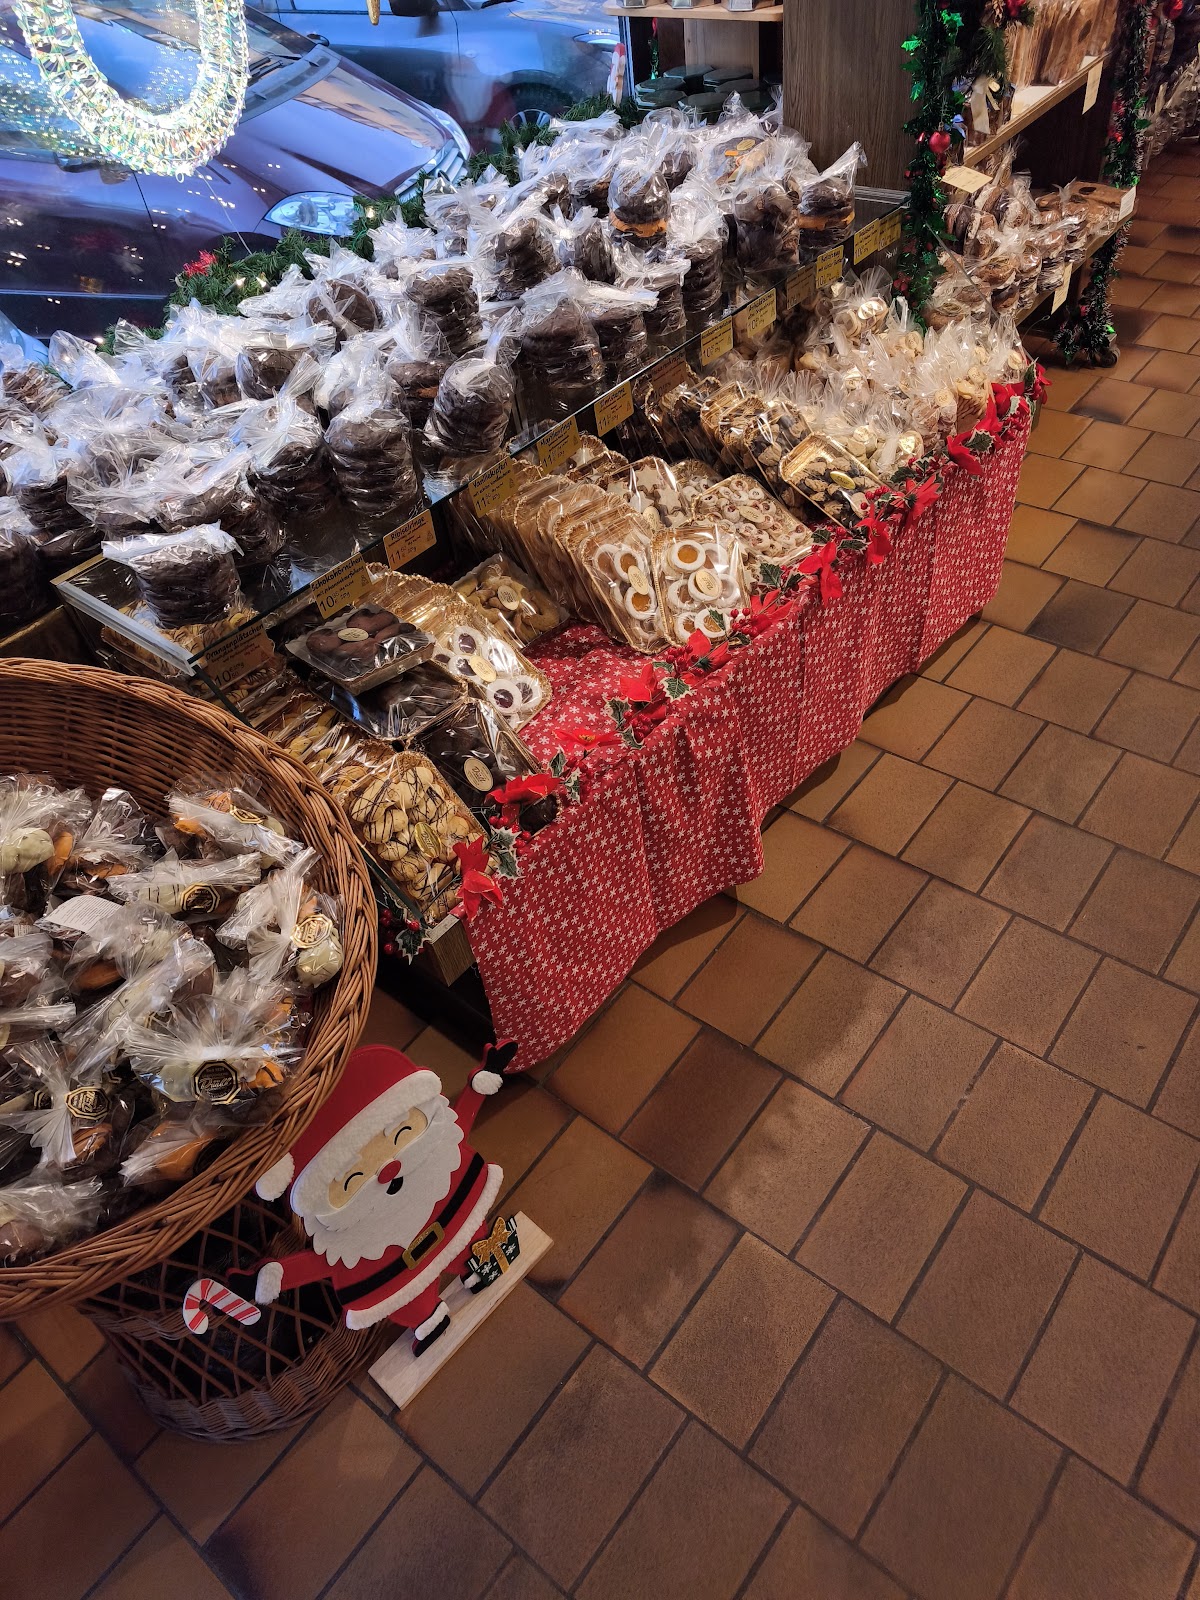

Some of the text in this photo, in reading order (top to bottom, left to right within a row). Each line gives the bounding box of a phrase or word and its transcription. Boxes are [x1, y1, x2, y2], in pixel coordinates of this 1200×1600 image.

[389, 550, 401, 564] 11
[311, 555, 363, 592] Schokohörnchen
[319, 595, 335, 612] 10
[205, 623, 264, 661] Orangenplätzchen
[214, 670, 232, 686] 10
